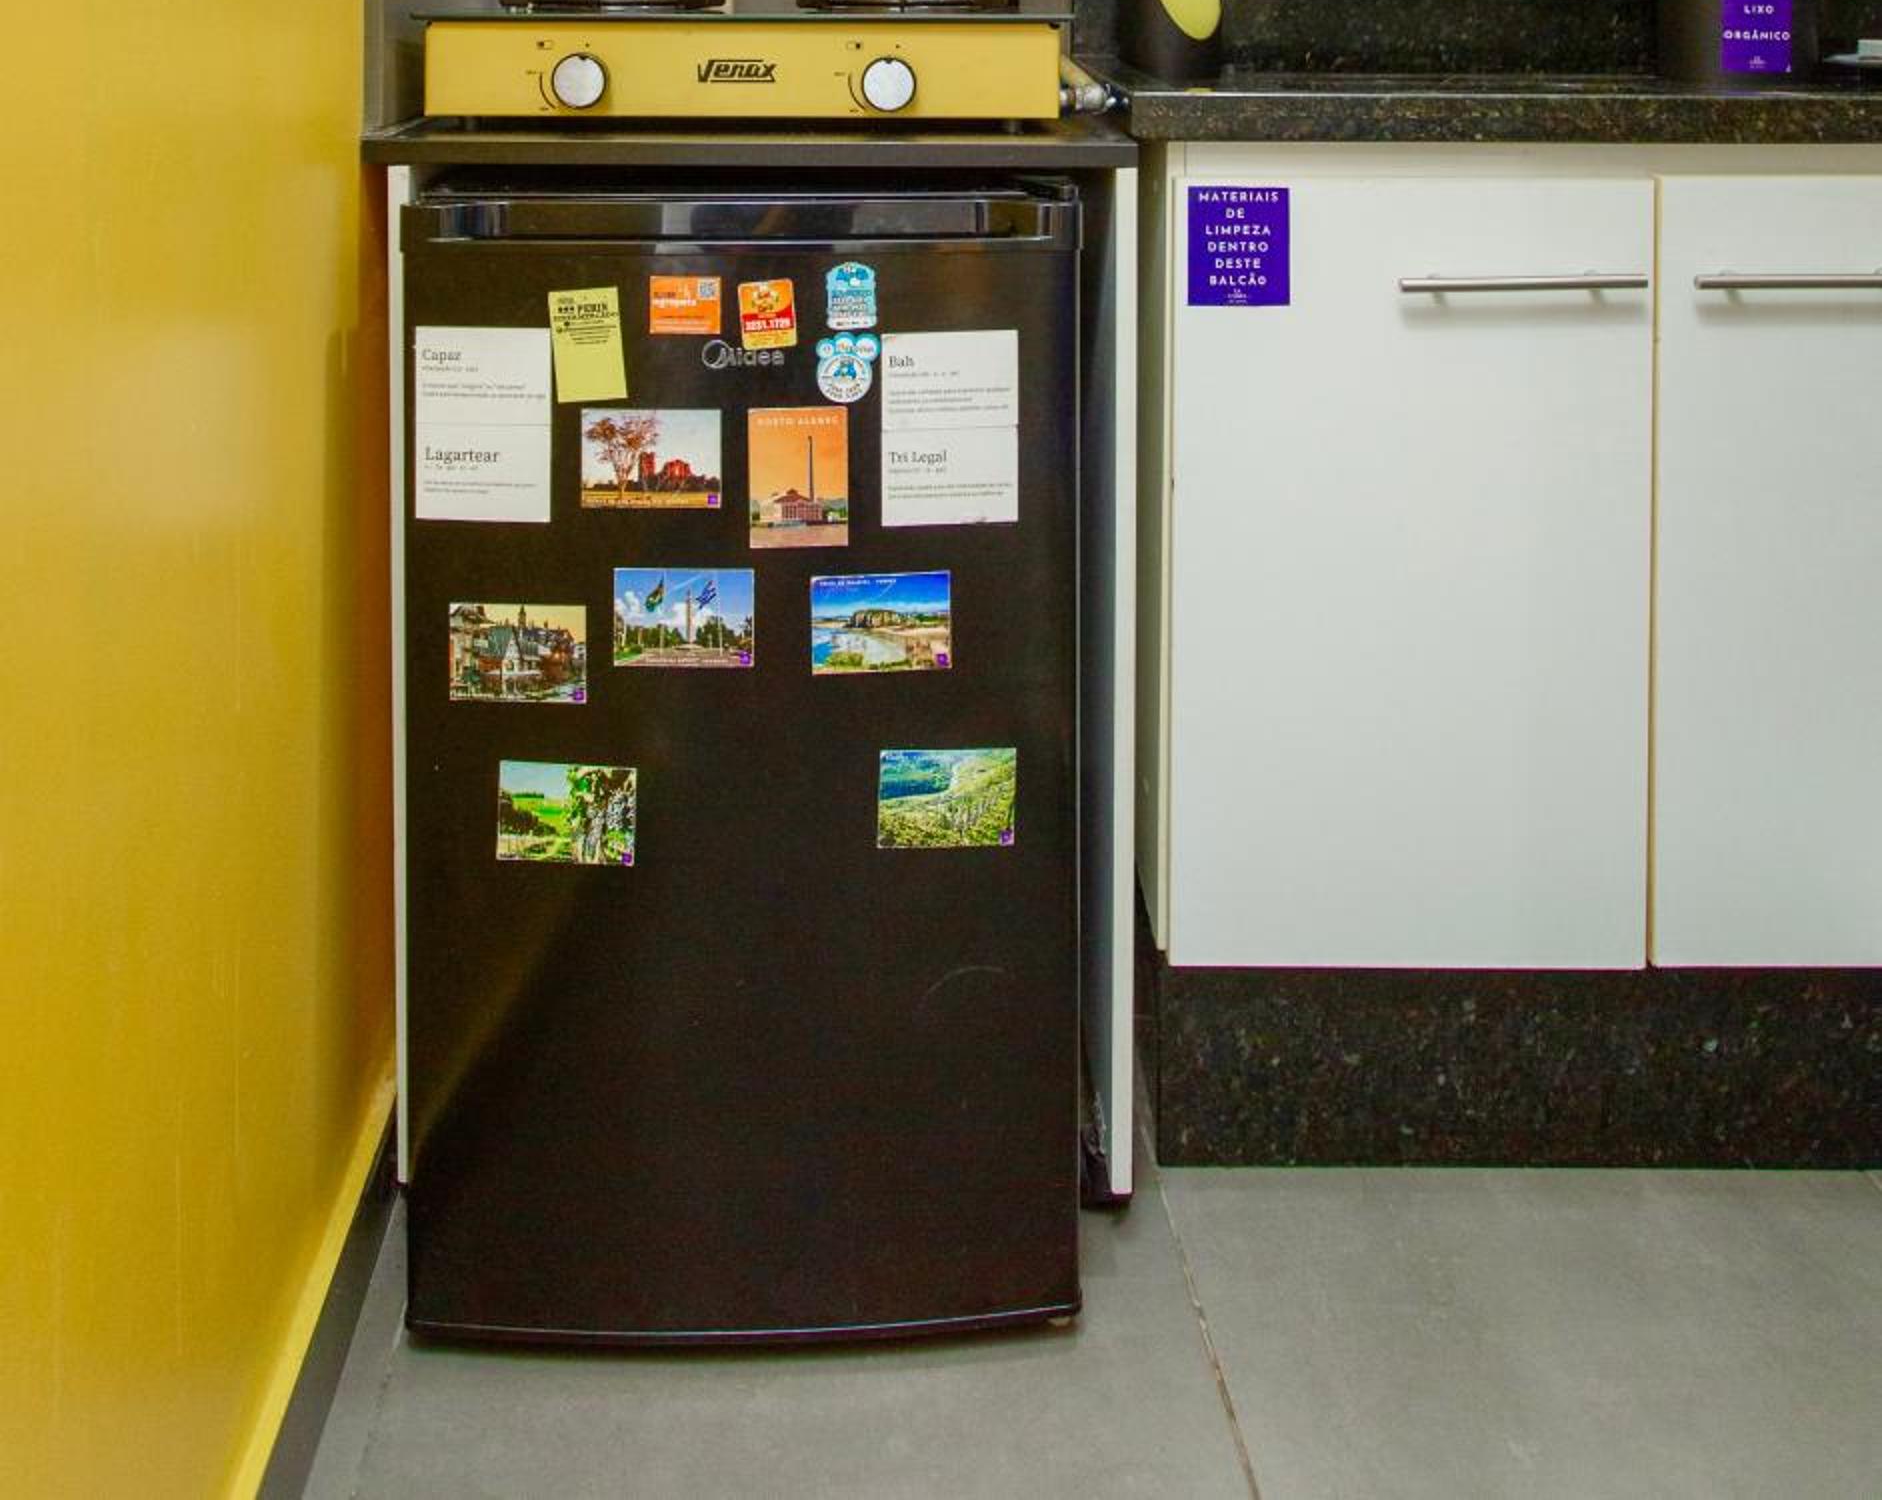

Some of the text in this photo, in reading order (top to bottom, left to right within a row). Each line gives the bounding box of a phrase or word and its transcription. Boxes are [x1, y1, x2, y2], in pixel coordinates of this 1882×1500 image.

[1743, 5, 1775, 14] LIXO
[1723, 29, 1791, 41] ORGÂNICO
[1199, 191, 1279, 202] MATERIAIS
[1225, 207, 1245, 219] DE
[1205, 225, 1271, 236] LIMPEZA
[1207, 241, 1269, 252] DENTRO
[1215, 258, 1262, 269] DESTE
[1209, 272, 1268, 285] BALCÃO
[421, 349, 462, 364] Capaz
[711, 346, 785, 368] Midea
[889, 356, 915, 368] Bah
[425, 446, 500, 464] Lagartear
[889, 450, 947, 465] Tri Legal
